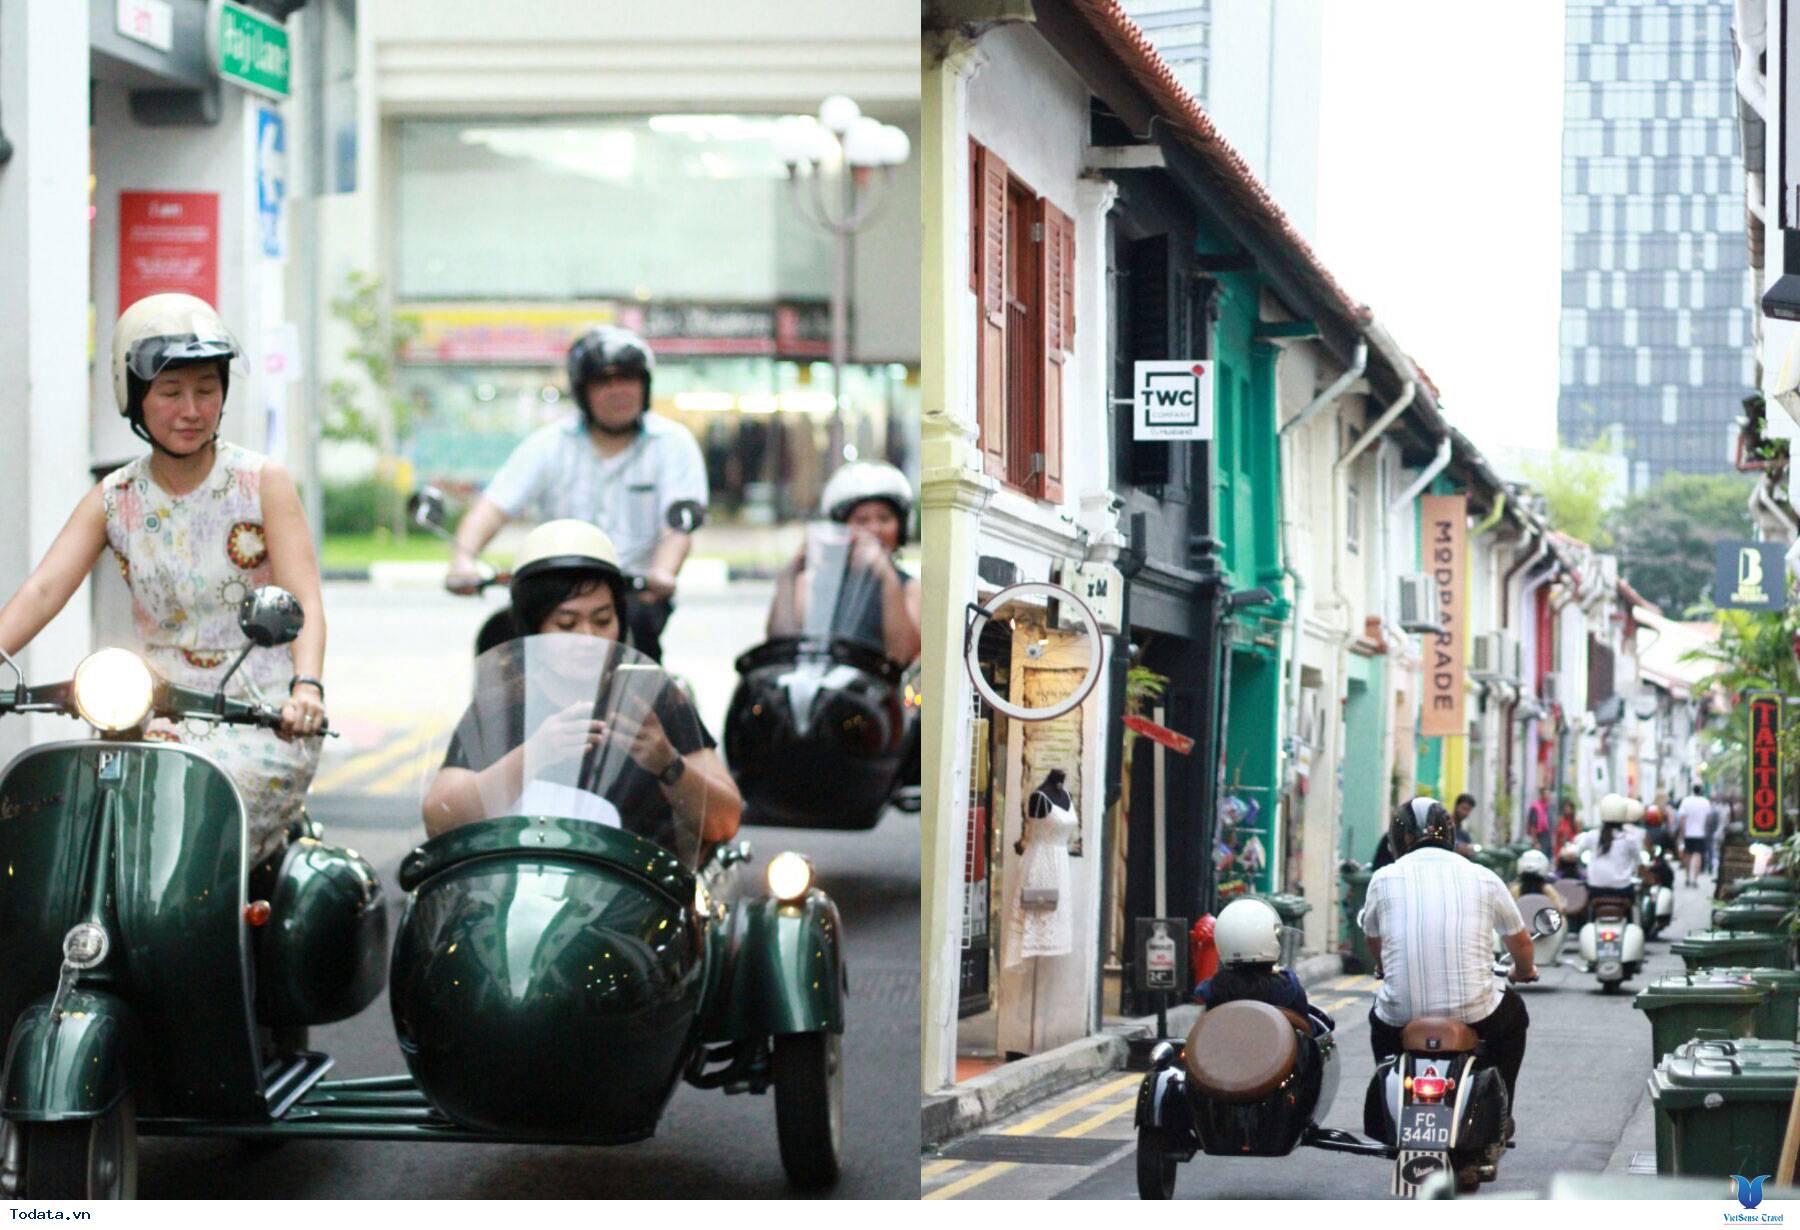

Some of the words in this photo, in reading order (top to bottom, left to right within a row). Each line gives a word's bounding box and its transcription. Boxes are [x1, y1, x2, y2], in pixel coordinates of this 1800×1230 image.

[1141, 390, 1194, 406] TWC
[1752, 703, 1777, 829] TATTOO
[1415, 1113, 1436, 1127] FC
[1402, 1128, 1448, 1142] 3441D
